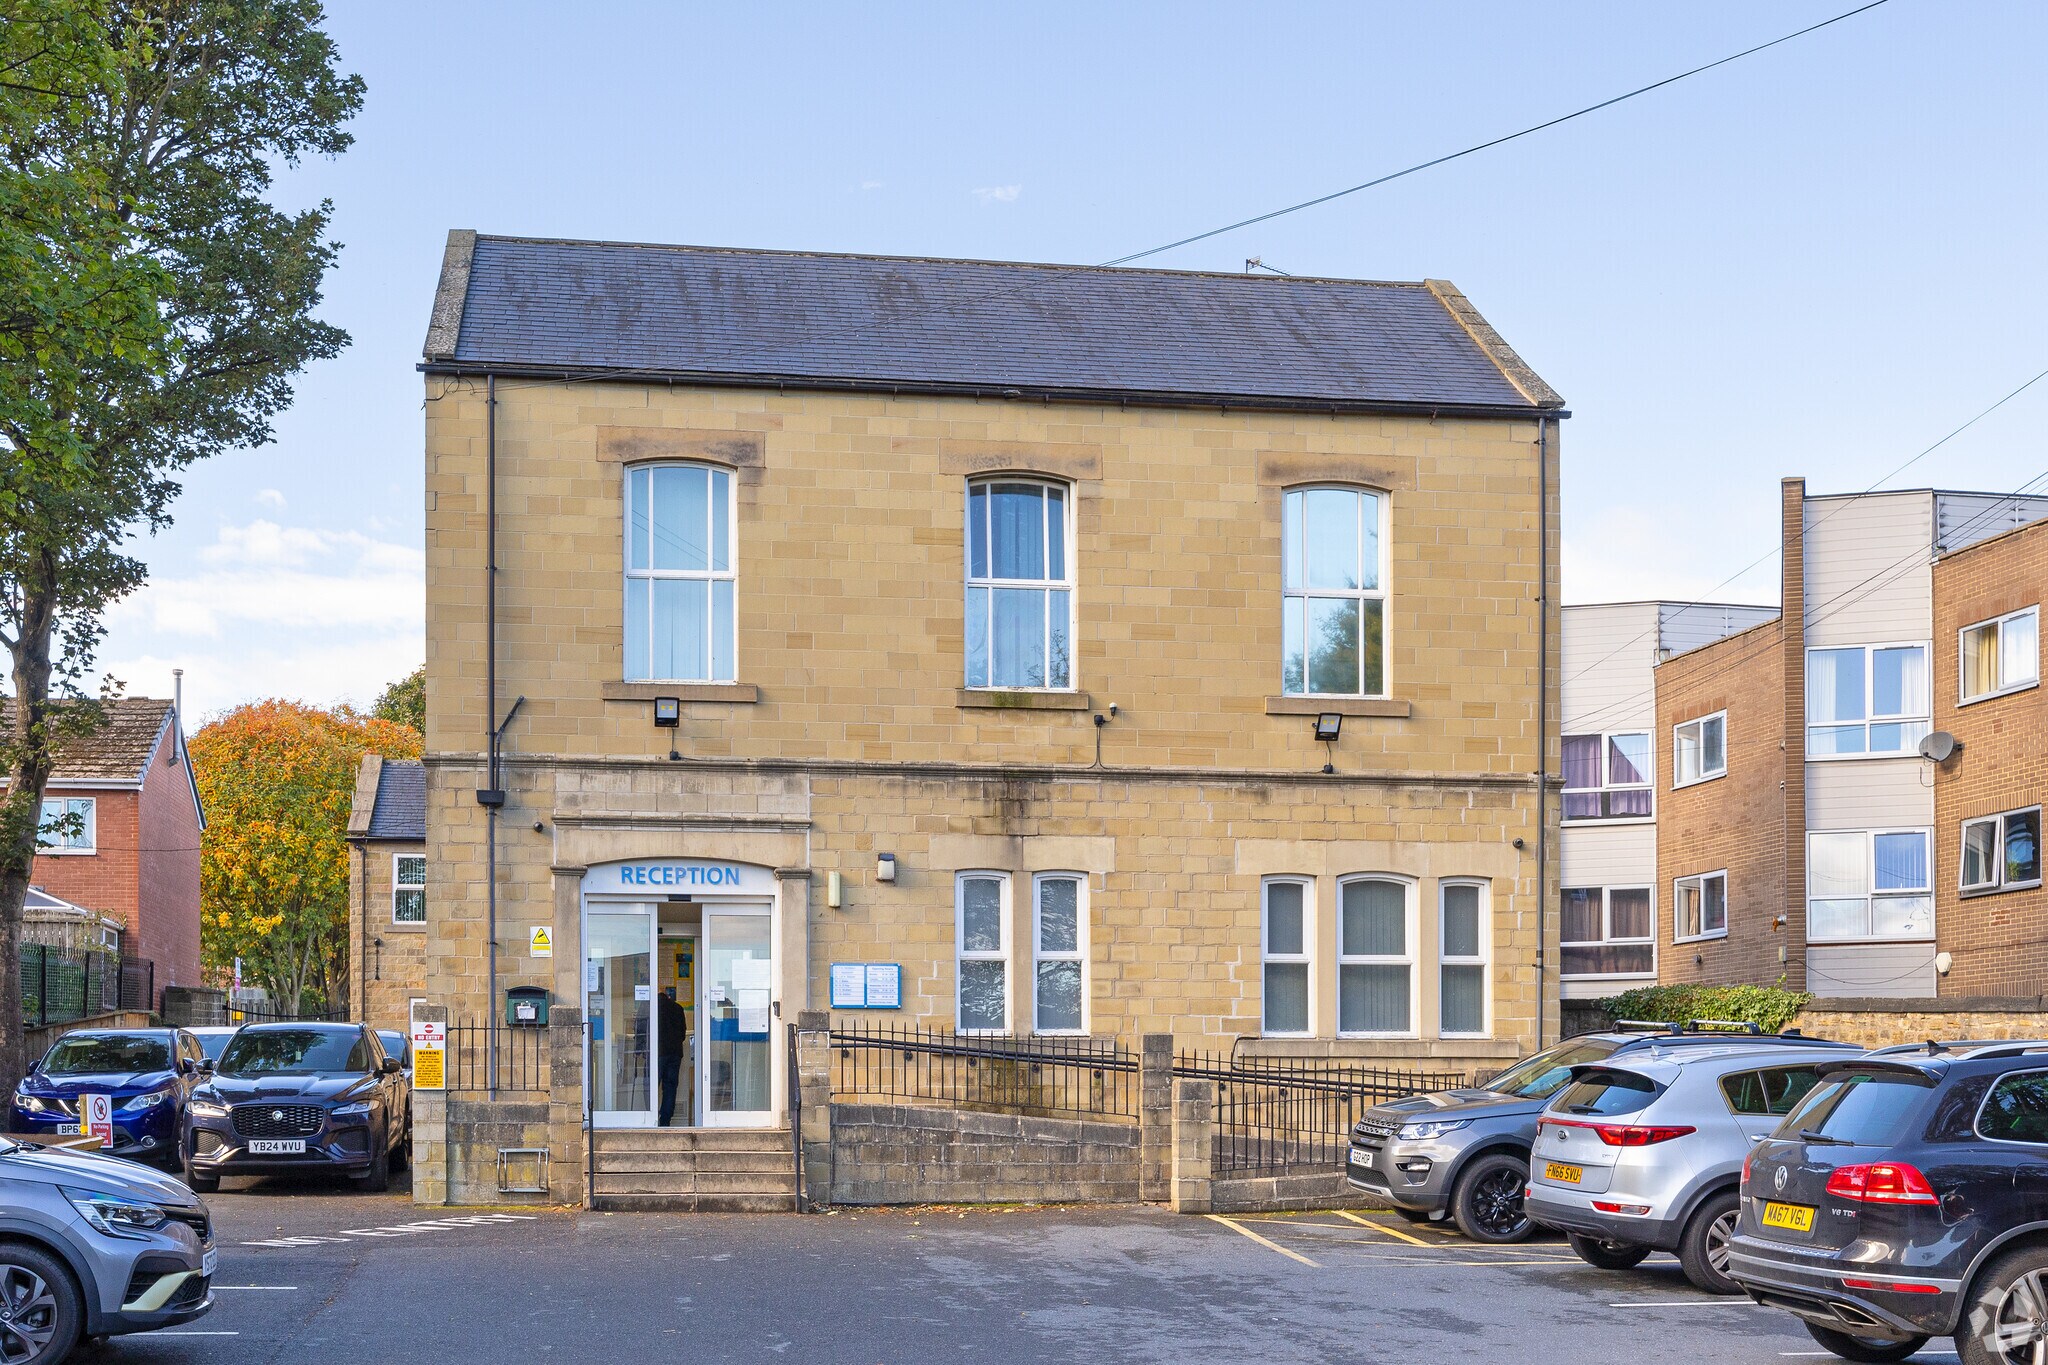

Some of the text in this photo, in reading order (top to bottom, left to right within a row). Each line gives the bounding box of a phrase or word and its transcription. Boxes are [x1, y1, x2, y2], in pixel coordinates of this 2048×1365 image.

[621, 866, 740, 885] RECEPTION
[61, 1125, 81, 1134] BP6
[253, 1142, 301, 1151] YB24 WVU
[1547, 1164, 1580, 1181] FN66 SVU
[1790, 1208, 1806, 1227] VGL
